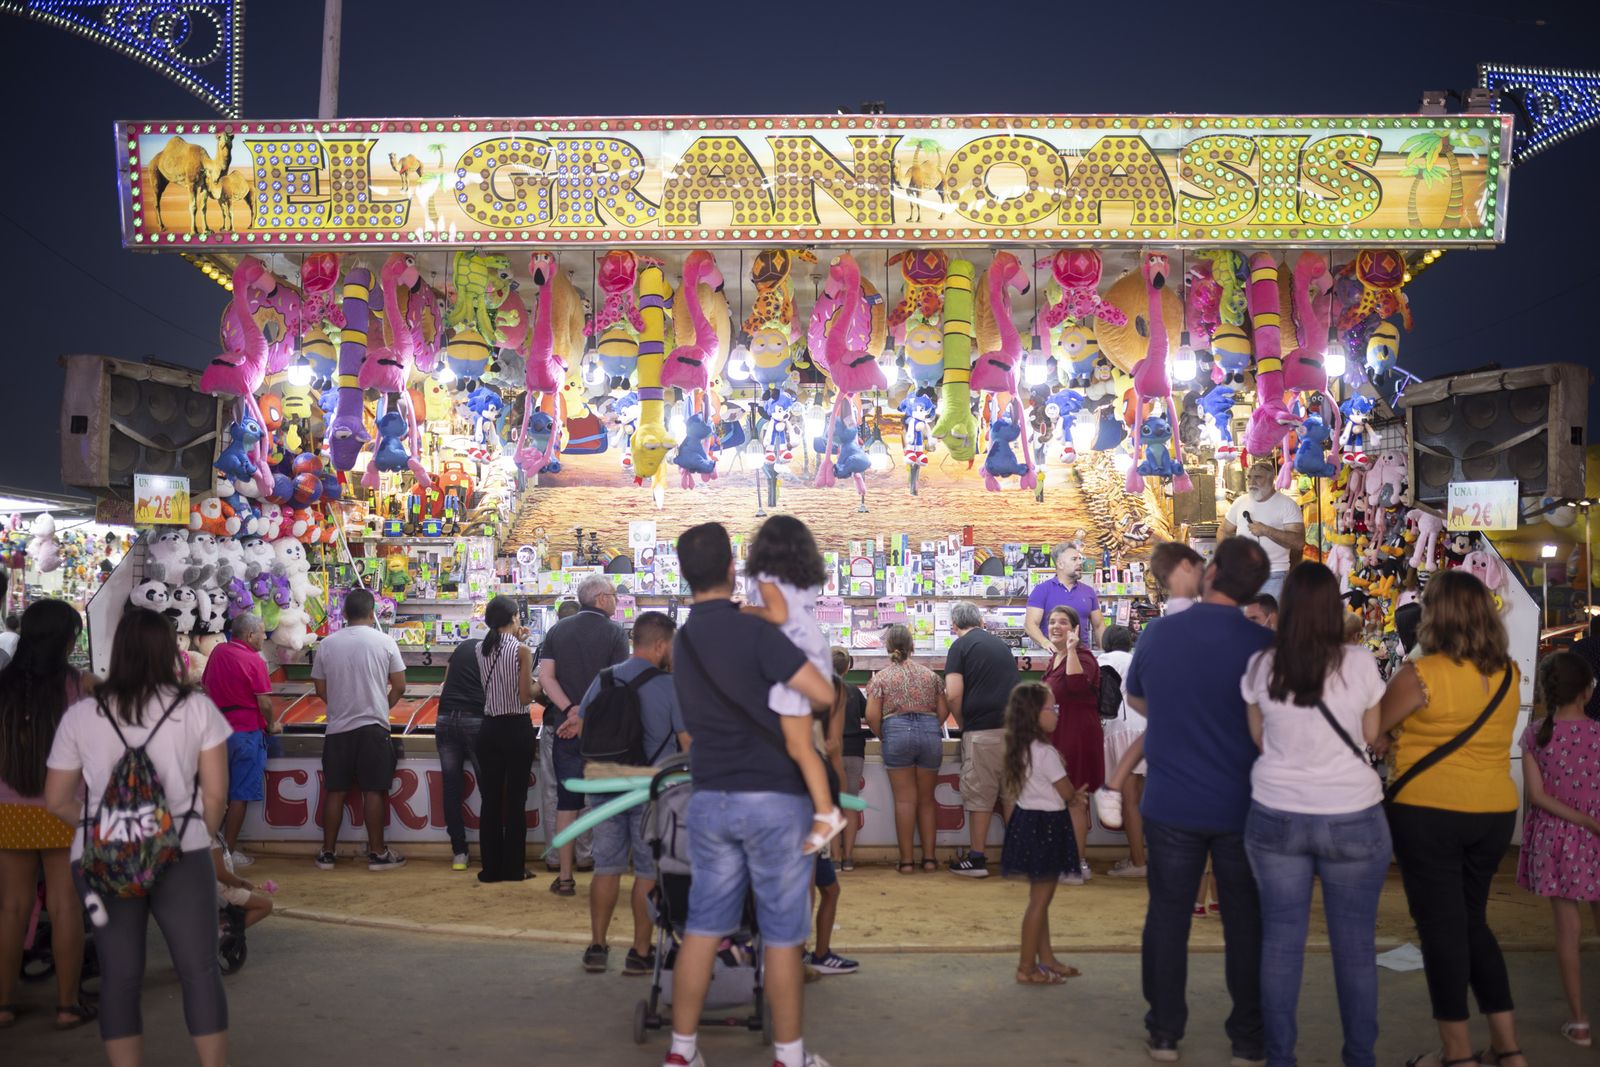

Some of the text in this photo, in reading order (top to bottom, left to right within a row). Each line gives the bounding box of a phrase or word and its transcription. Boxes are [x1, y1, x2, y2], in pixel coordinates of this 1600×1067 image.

[245, 133, 1384, 231] EL GRAN OASIS
[1454, 487, 1473, 497] UNA
[154, 495, 172, 519] 2€
[1471, 502, 1493, 527] 2€
[422, 651, 432, 666] 3
[100, 804, 159, 843] VANS
